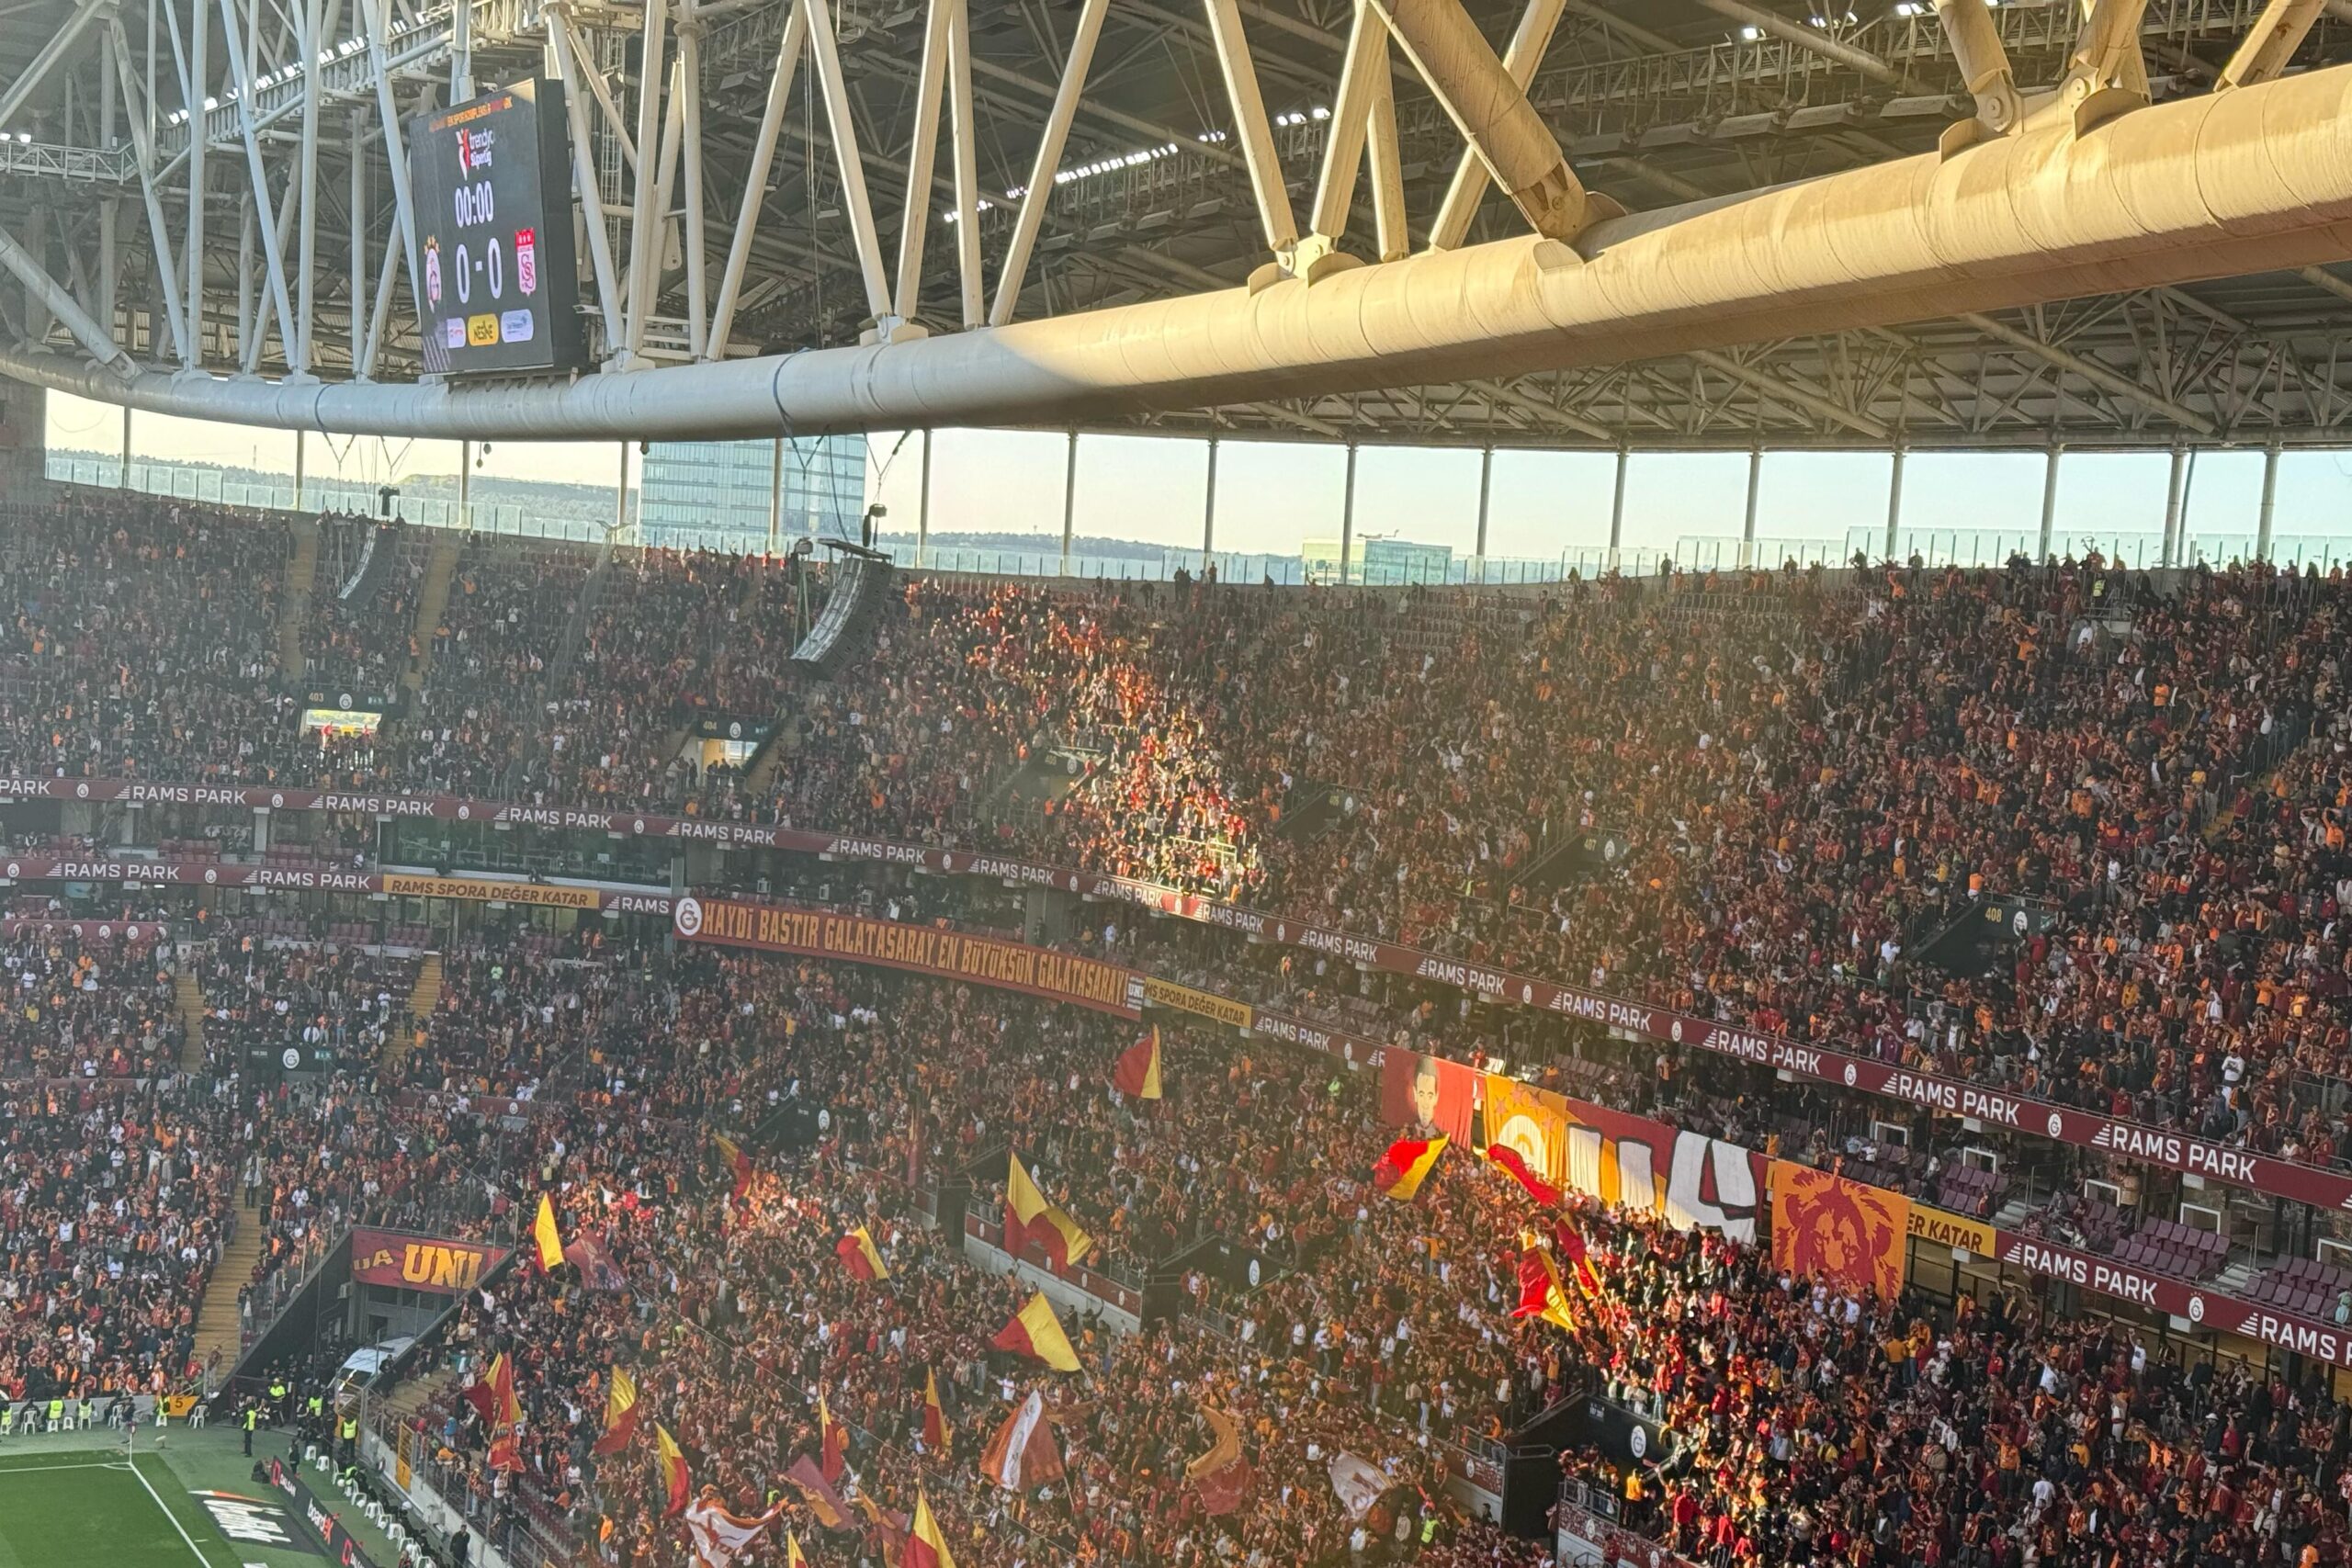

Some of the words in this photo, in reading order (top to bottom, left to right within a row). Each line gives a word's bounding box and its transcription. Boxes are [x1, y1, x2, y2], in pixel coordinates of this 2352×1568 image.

[455, 180, 494, 229] 00:00
[308, 692, 324, 703] 403
[0, 779, 51, 795] PARK
[133, 785, 189, 803] RAMS
[196, 789, 247, 805] PARK
[326, 795, 380, 811] RAMS
[386, 799, 435, 816] PARK
[510, 807, 560, 825] RAMS
[566, 812, 613, 829] PARK
[681, 822, 729, 840] RAMS
[734, 829, 776, 846] PARK
[840, 840, 883, 858] RAMS
[887, 845, 927, 864] PARK
[64, 863, 121, 878] RAMS
[128, 864, 179, 880] PARK
[260, 870, 314, 886] RAMS
[320, 874, 370, 890] PARK
[980, 859, 1018, 879] RAMS
[1022, 866, 1055, 886] PARK
[391, 880, 435, 895] RAMS
[436, 883, 487, 898] SPORA
[492, 884, 540, 903] DEĞER
[543, 889, 589, 907] KATAR
[622, 897, 670, 914] RAMS
[1102, 880, 1133, 902] RAMS
[1135, 888, 1163, 908] PARK
[1203, 905, 1233, 926] RAMS
[1235, 913, 1264, 934] PARK
[1984, 907, 2003, 923] 408
[758, 909, 819, 950] BASTIR
[937, 934, 957, 971] EN
[961, 939, 1035, 987] BÜYÜKSÜN
[1308, 930, 1342, 955] RAMS
[1345, 940, 1378, 964] PARK
[1427, 959, 1466, 987] RAMS
[1469, 970, 1506, 997] PARK
[1159, 987, 1186, 1008] SPORA
[1188, 993, 1216, 1015] DEĞER
[1216, 1005, 1245, 1026] KATAR
[1563, 992, 1606, 1021] RAMS
[1610, 1004, 1651, 1032] PARK
[1264, 1017, 1296, 1041] RAMS
[1299, 1028, 1330, 1052] PARK
[1718, 1030, 1769, 1062] RAMS
[1772, 1044, 1822, 1077] PARK
[1899, 1075, 1957, 1110] RAMS
[1963, 1090, 2020, 1126] PARK
[2112, 1125, 2182, 1164] RAMS
[2188, 1144, 2256, 1184] PARK
[1928, 1219, 1983, 1253] KATAR
[402, 1243, 483, 1290] UNI
[2023, 1245, 2088, 1284] RAMS
[2094, 1266, 2158, 1306] PARK
[2261, 1314, 2337, 1361] RAMS
[174, 1397, 184, 1409] 5
